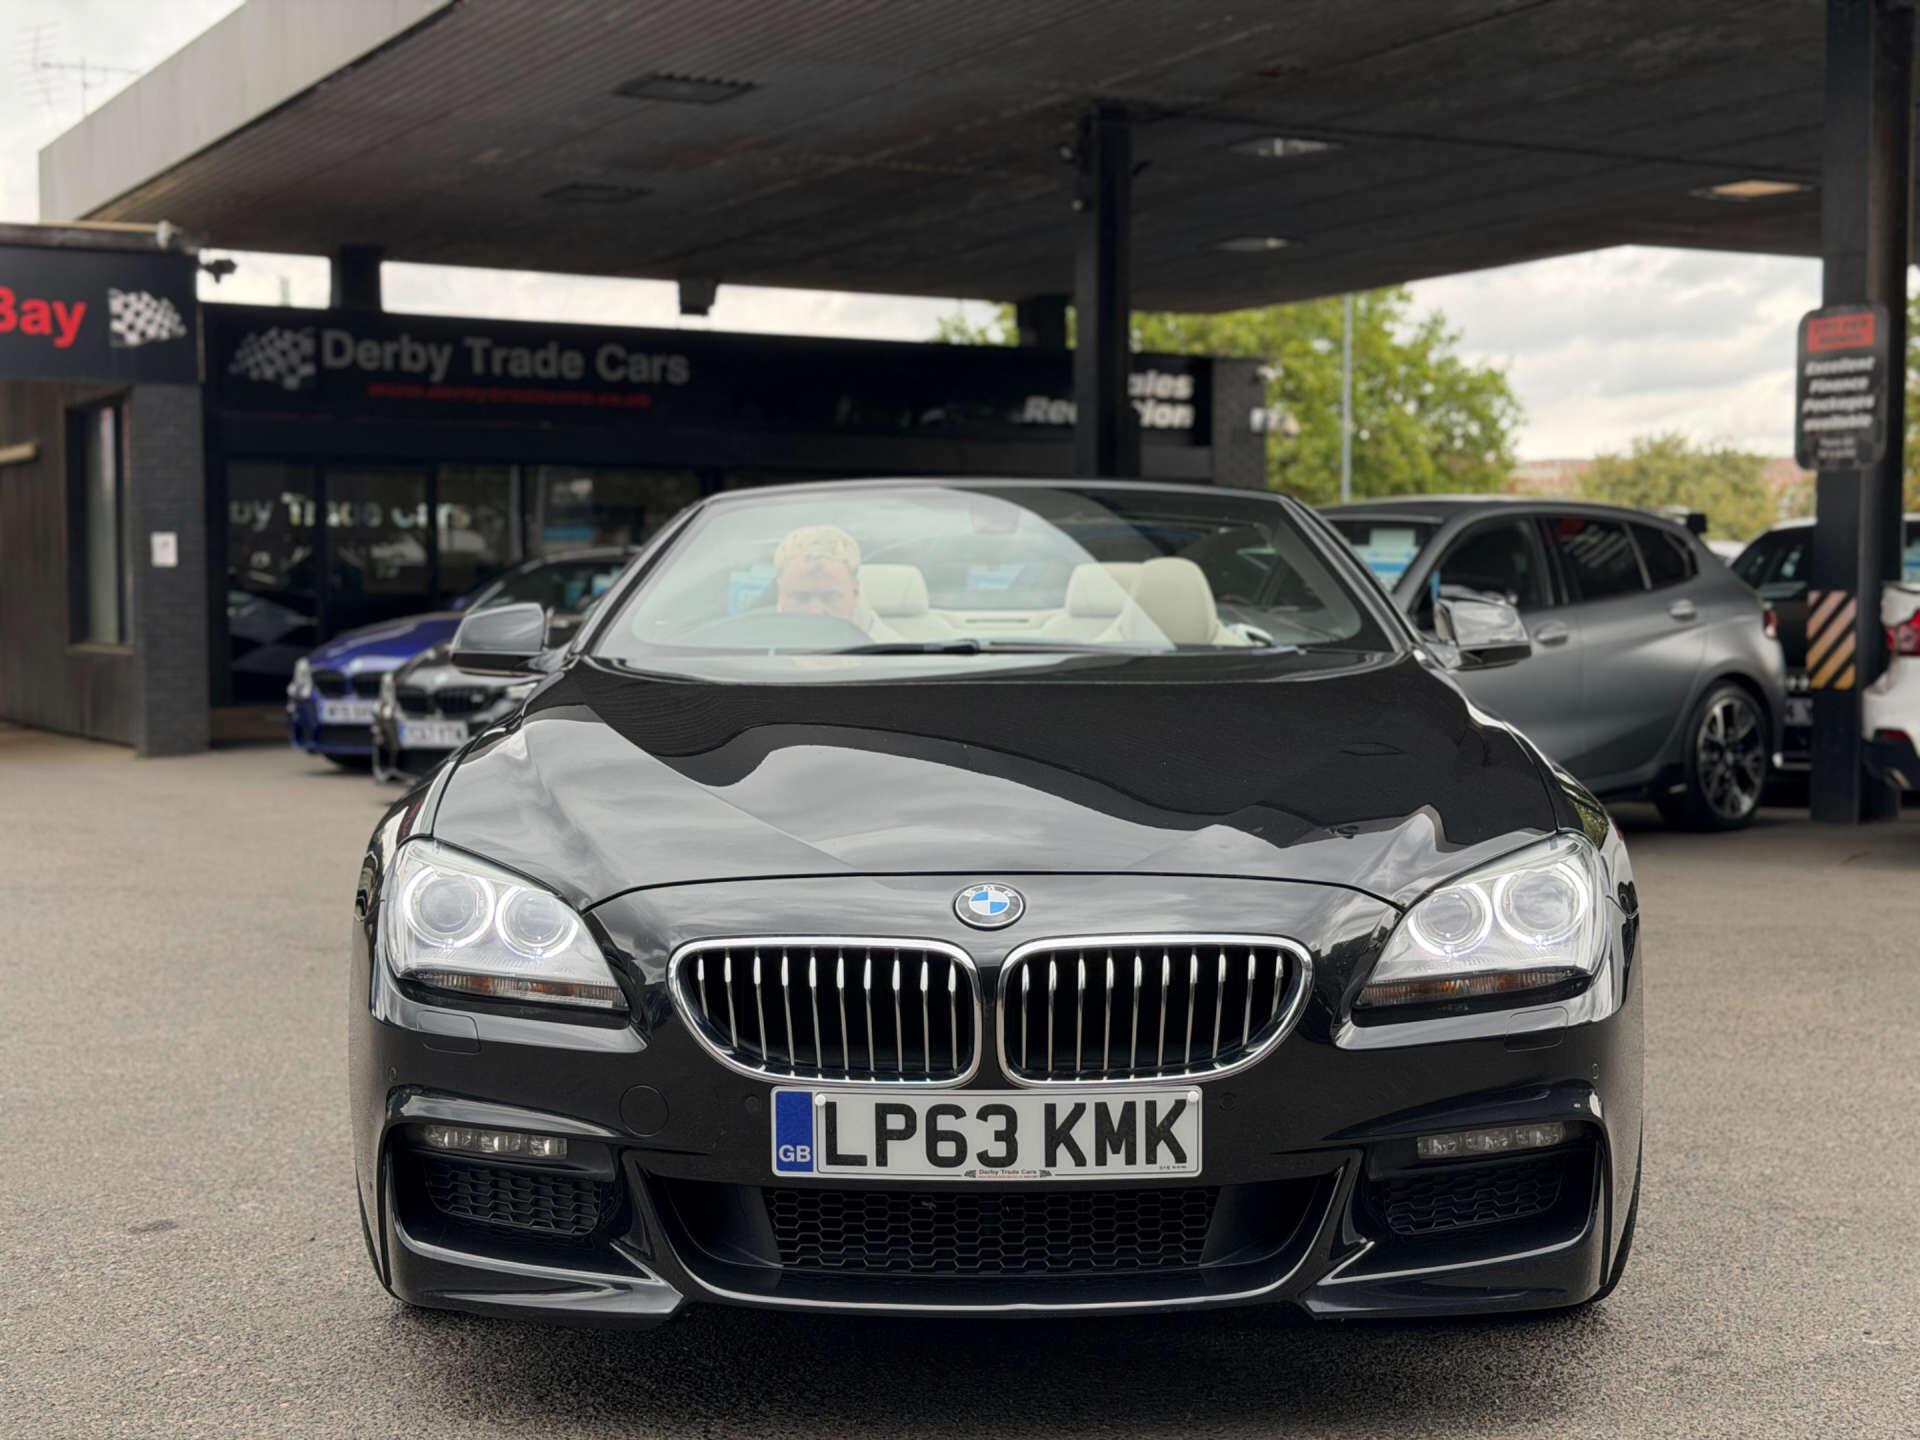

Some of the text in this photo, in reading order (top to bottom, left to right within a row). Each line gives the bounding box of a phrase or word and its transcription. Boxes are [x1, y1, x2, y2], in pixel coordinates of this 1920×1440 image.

[0, 285, 87, 349] Bay
[321, 329, 690, 385] Derby Trade Cars
[1127, 369, 1194, 399] ales
[778, 1144, 812, 1163] GB
[825, 1099, 1187, 1168] LP63 KMK
